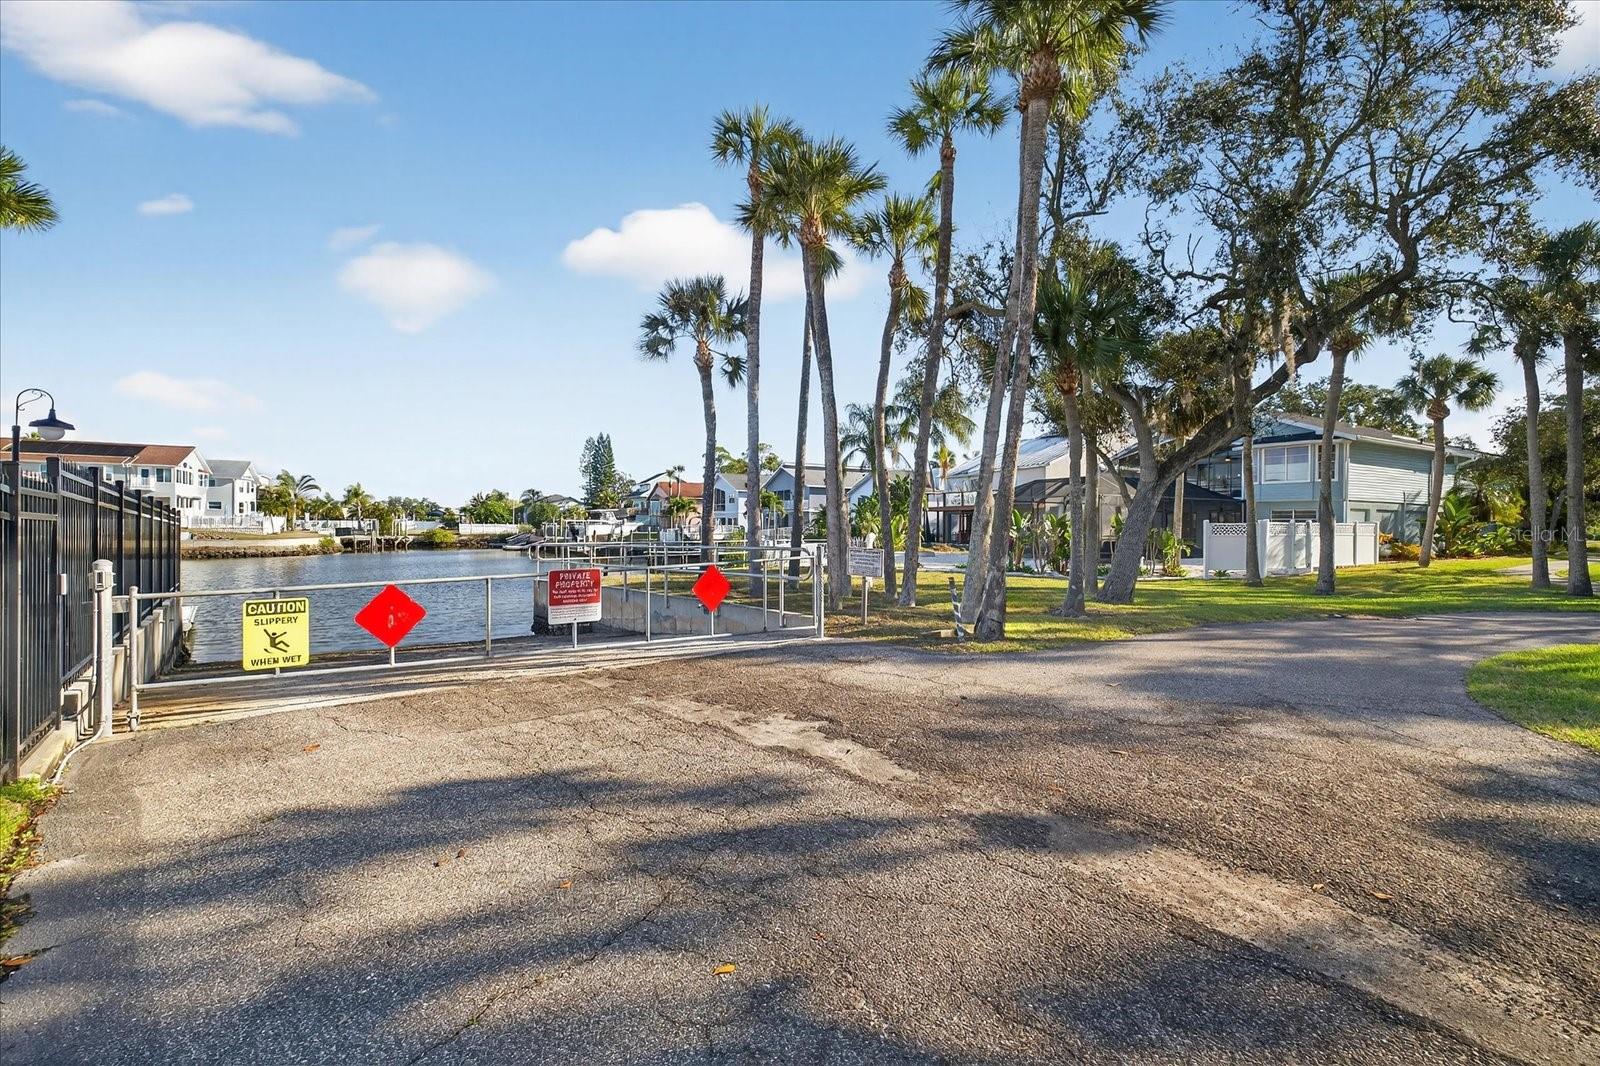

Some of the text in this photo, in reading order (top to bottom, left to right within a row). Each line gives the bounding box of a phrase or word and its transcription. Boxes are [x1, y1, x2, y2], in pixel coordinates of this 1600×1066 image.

[560, 571, 591, 580] PRIVATE
[555, 580, 594, 588] PROPERTY
[247, 602, 305, 615] CAUTION
[254, 616, 298, 625] SLIPPERY
[251, 655, 301, 666] WHEN WET
